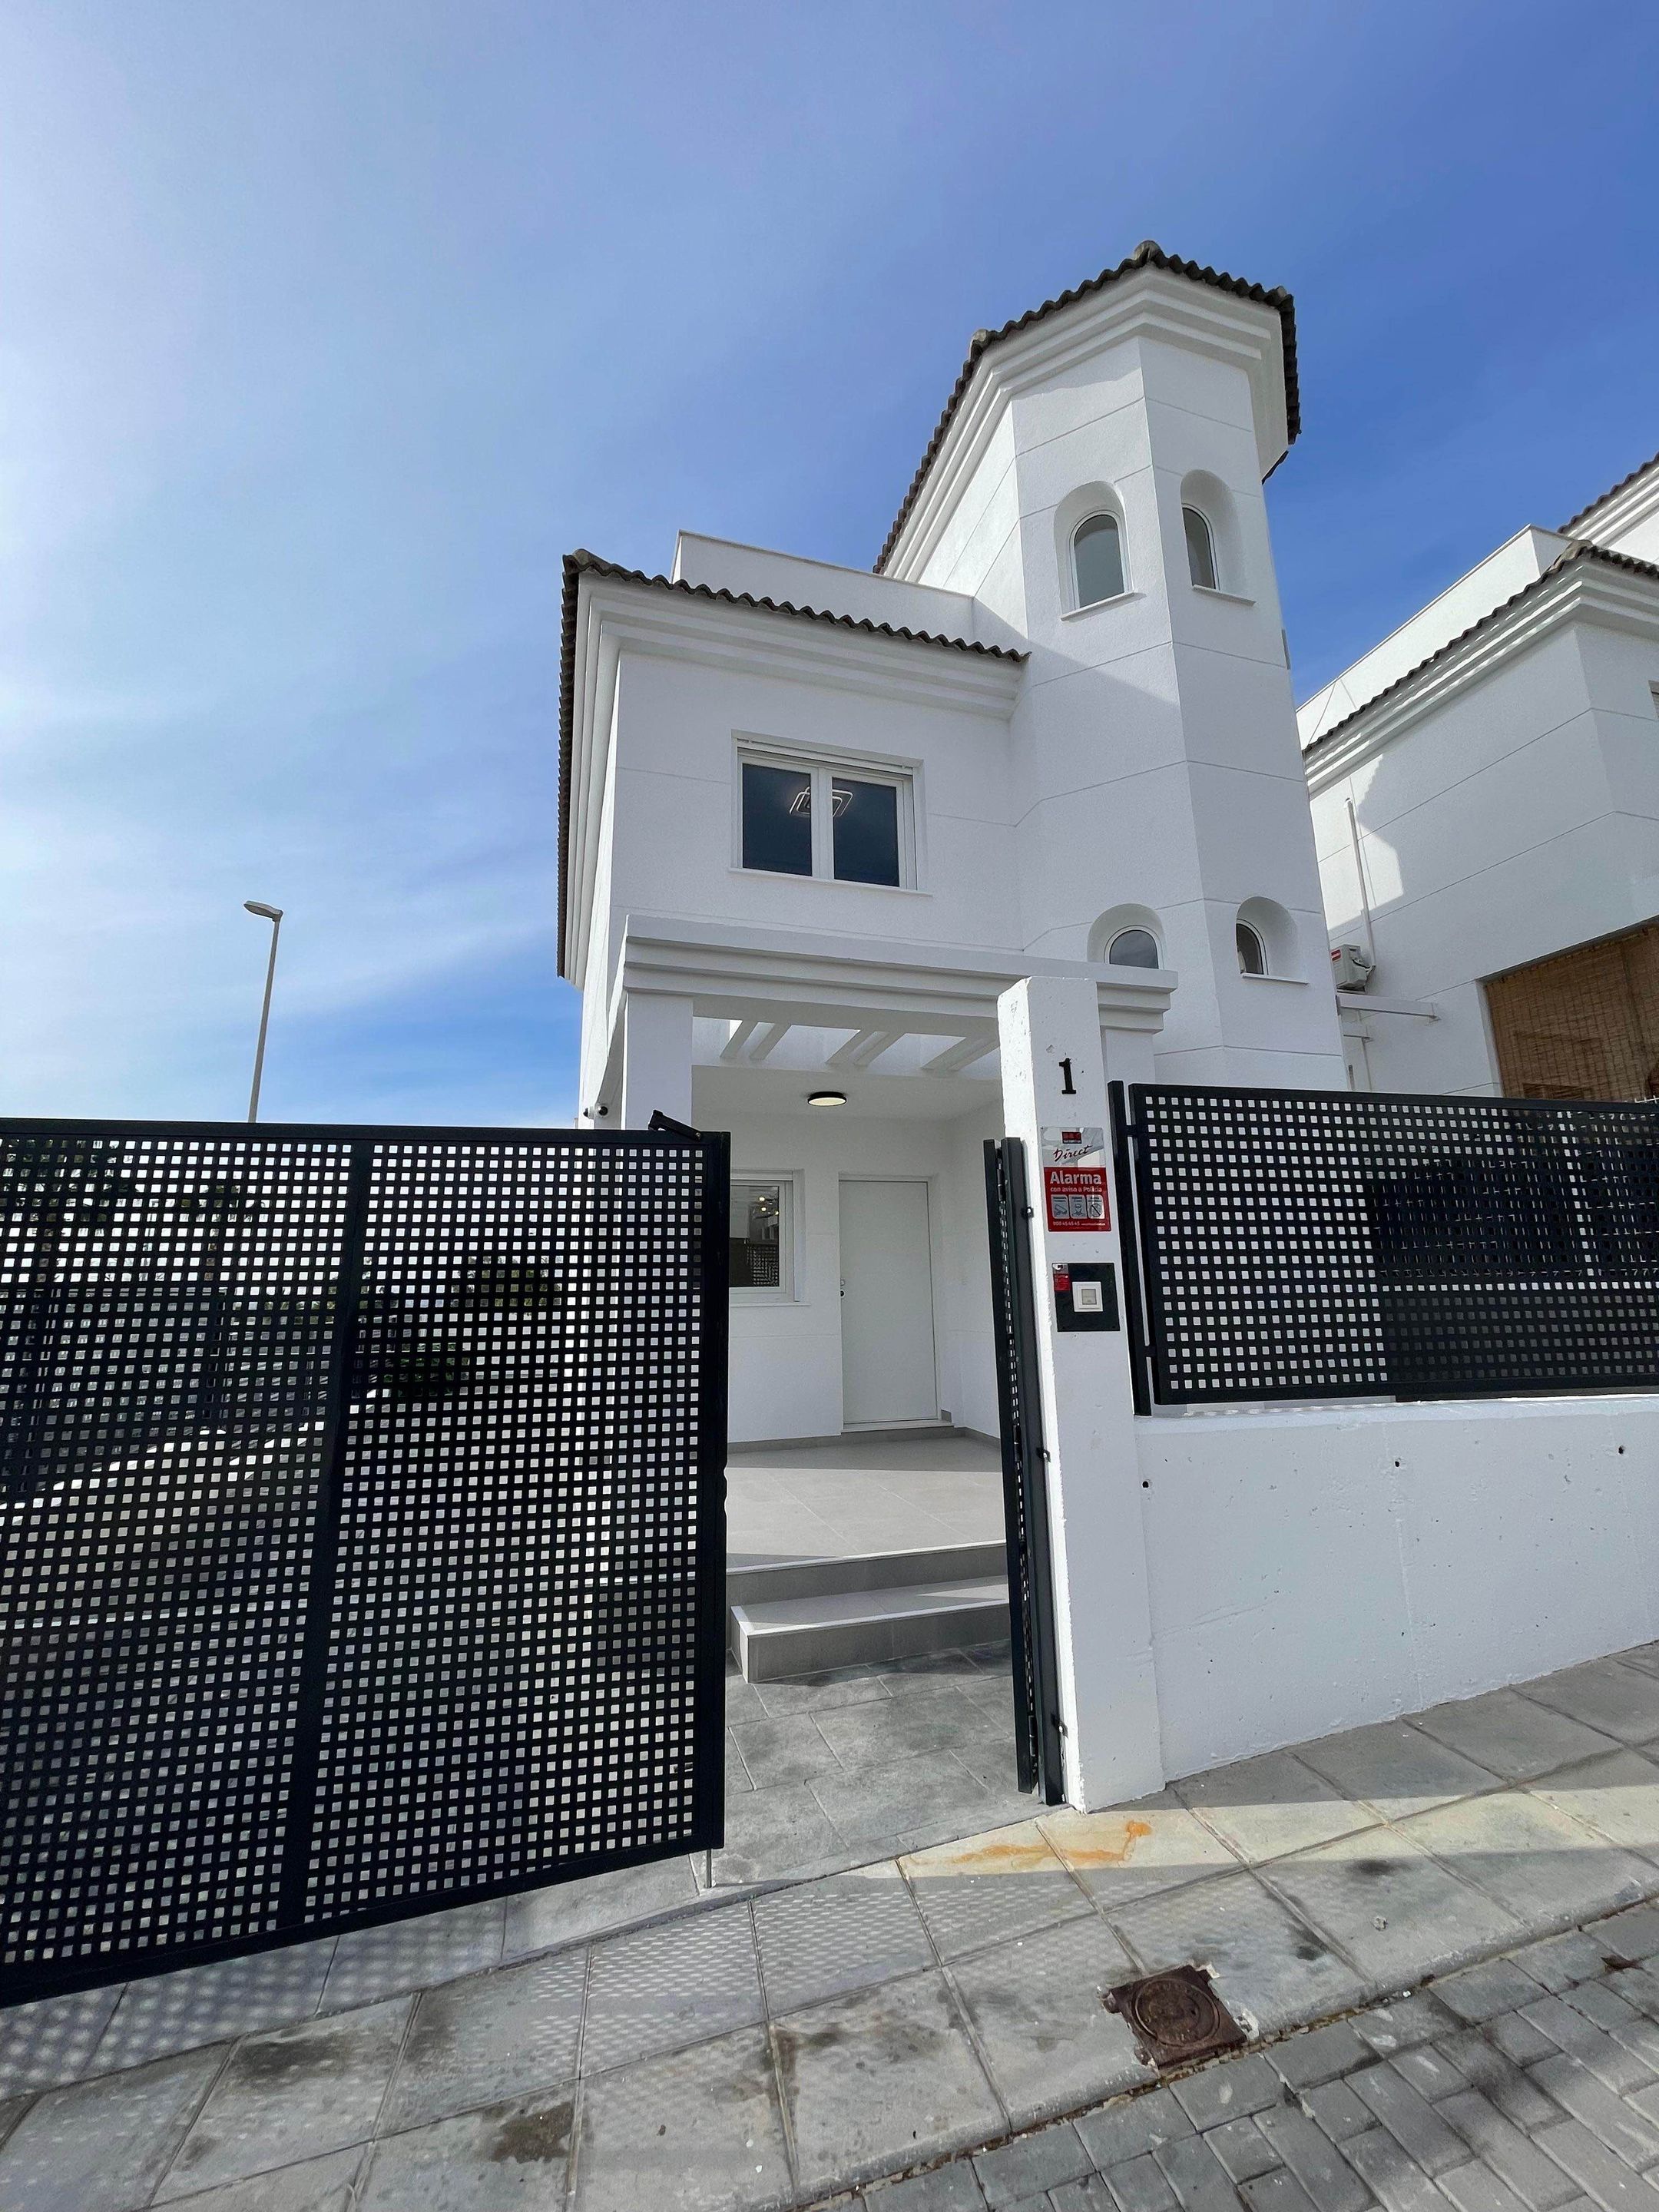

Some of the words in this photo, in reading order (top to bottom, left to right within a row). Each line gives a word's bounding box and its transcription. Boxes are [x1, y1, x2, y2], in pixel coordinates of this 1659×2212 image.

[1058, 1058, 1076, 1094] 1
[1053, 1144, 1093, 1162] Direct
[1050, 1171, 1102, 1184] Alarma
